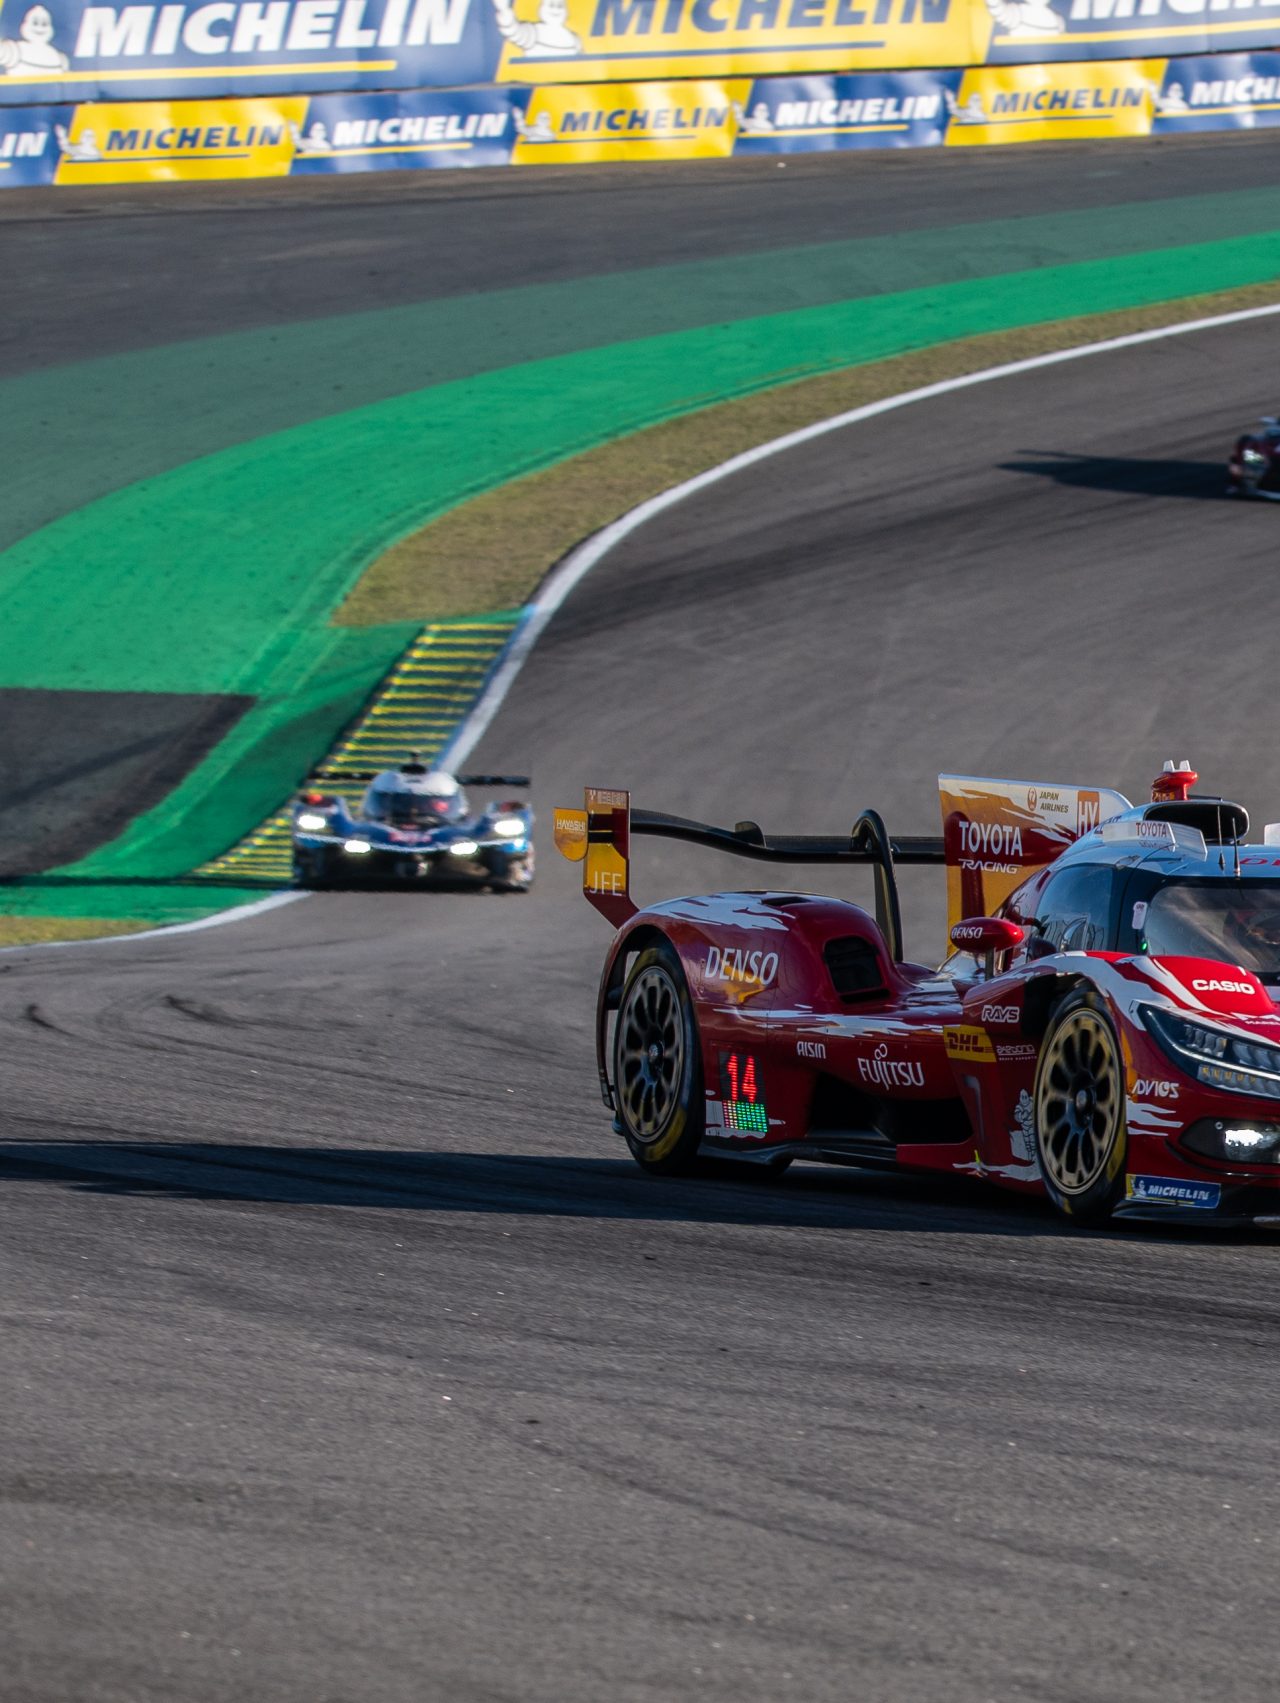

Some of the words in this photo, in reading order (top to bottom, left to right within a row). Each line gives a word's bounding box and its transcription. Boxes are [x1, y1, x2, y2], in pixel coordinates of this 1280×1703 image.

[75, 0, 470, 58] MICHELIN
[775, 95, 941, 126] MICHELIN
[991, 87, 1144, 114] MICHELIN
[333, 113, 508, 146] MICHELIN
[560, 107, 730, 133] MICHELIN
[105, 125, 285, 152] MICHELIN
[1039, 791, 1060, 801] JAPAN
[1040, 803, 1070, 814] AIRLINES
[556, 818, 586, 832] HAYASHI
[1077, 800, 1099, 838] HY
[1135, 822, 1168, 838] TOYOTA
[959, 820, 1024, 857] TOYOTA
[958, 858, 1023, 875] RACING
[589, 870, 623, 897] JFE
[951, 926, 984, 940] DENSO
[704, 945, 780, 986] DENSO
[1192, 978, 1256, 995] CASIO
[981, 1004, 1020, 1024] RAYS
[796, 1040, 827, 1060] AISIN
[946, 1031, 985, 1054] DHL
[726, 1053, 759, 1103] 14
[858, 1056, 925, 1091] FUJITSU
[1147, 1183, 1210, 1201] MICHELIN
